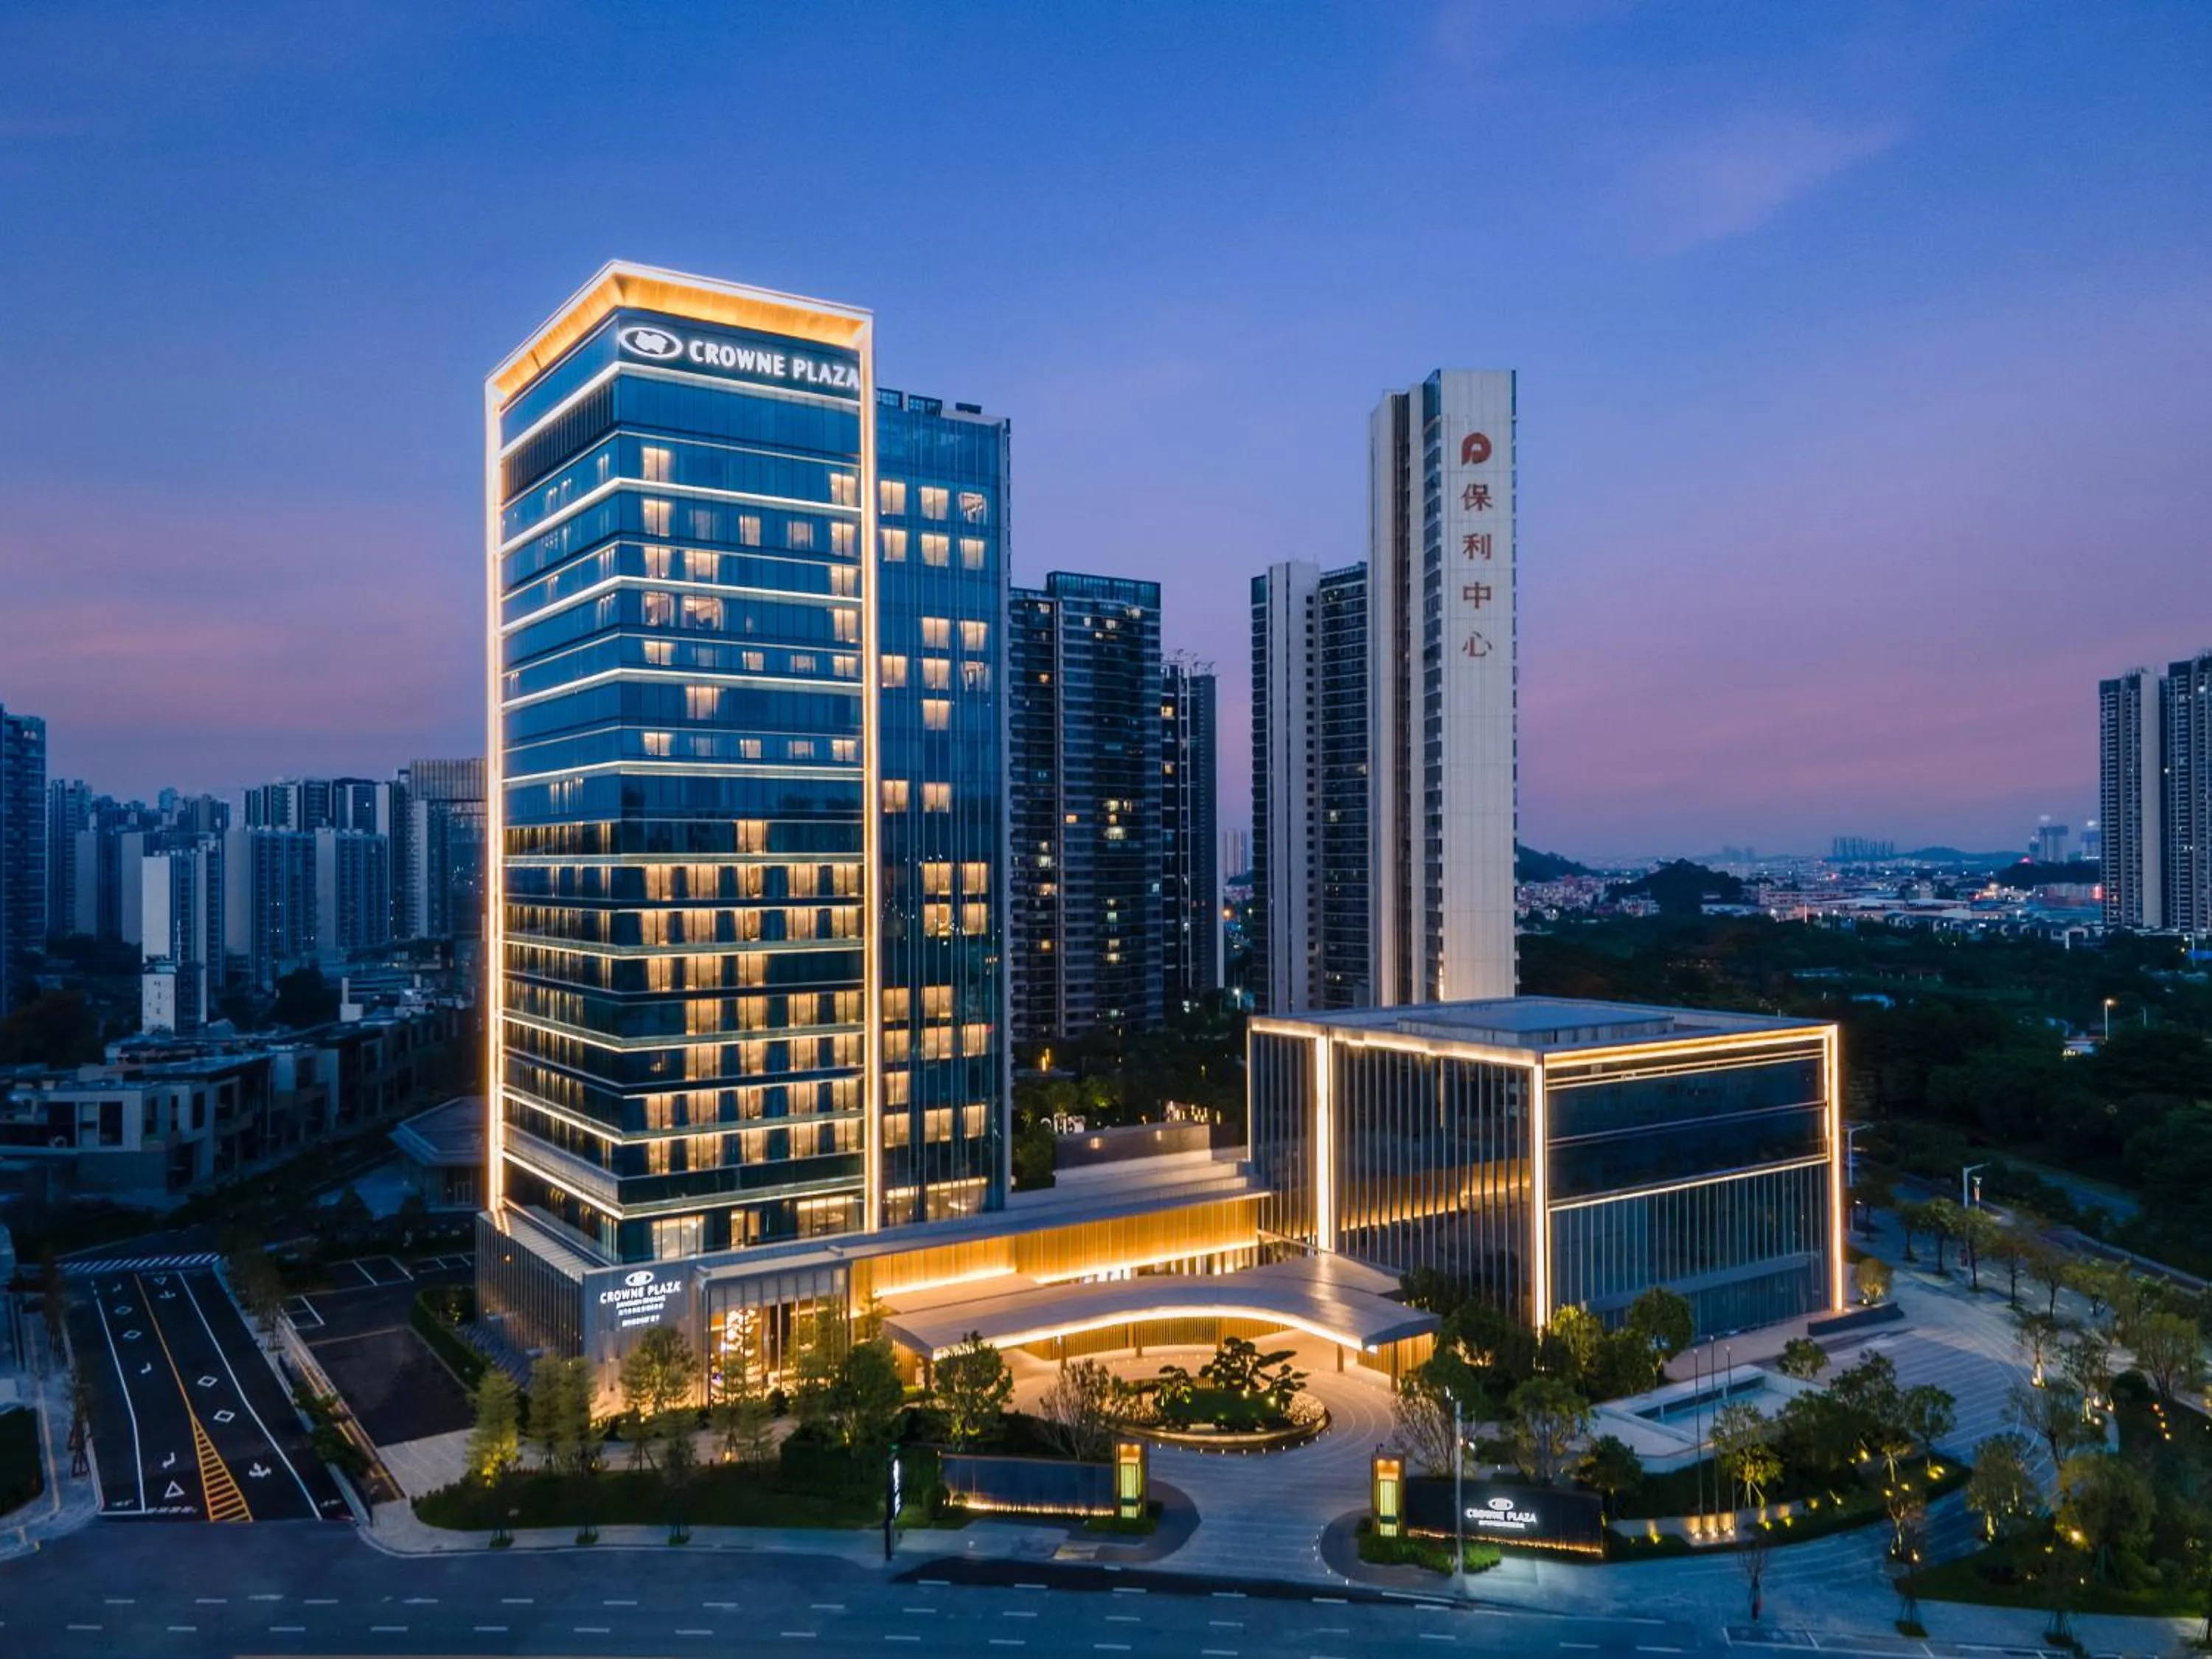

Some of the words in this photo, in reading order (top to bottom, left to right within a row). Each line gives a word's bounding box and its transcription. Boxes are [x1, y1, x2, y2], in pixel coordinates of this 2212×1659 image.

[689, 340, 785, 377] CROWNE
[792, 358, 860, 391] PLAZA
[1461, 483, 1493, 658] 保利中心
[599, 1286, 644, 1304] CROWNE
[647, 1280, 682, 1296] PLAZA
[1506, 1511, 1537, 1523] PLAZA
